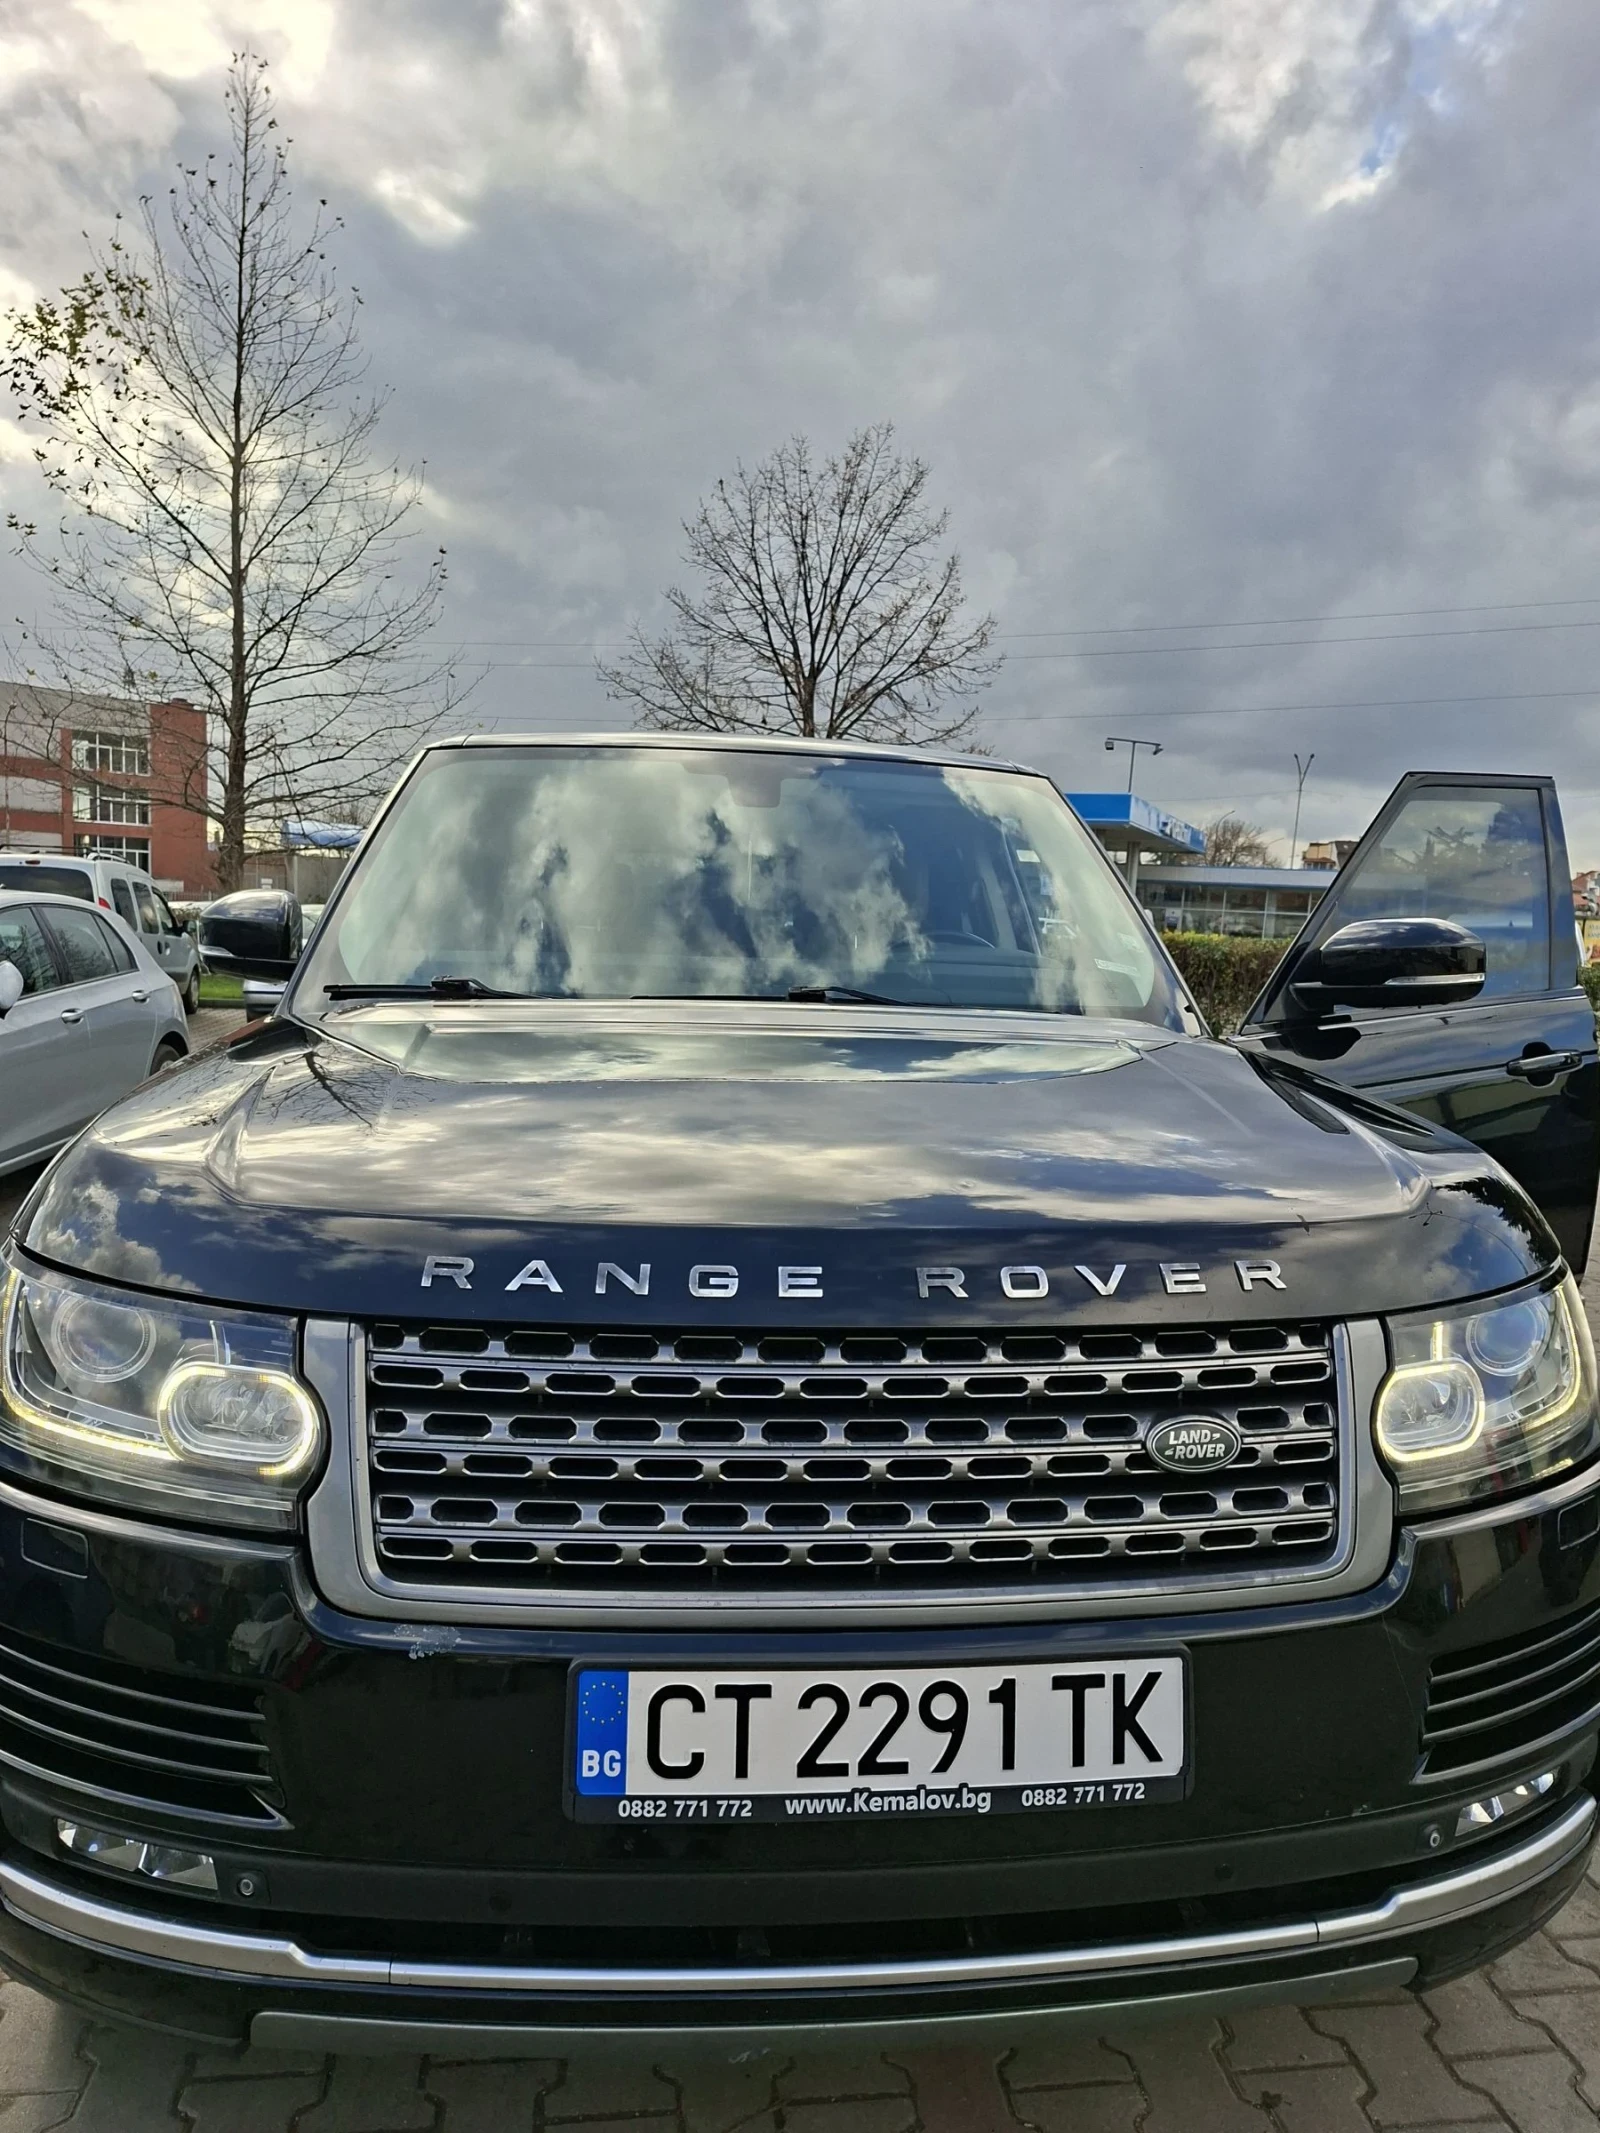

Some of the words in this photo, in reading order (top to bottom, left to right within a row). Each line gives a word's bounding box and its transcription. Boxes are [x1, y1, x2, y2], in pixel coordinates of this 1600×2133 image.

[420, 1255, 824, 1299] RANGE
[916, 1259, 1288, 1299] ROVER
[1168, 1429, 1211, 1445] LAND
[1174, 1443, 1226, 1460] ROVER
[646, 1683, 773, 1780] CT
[795, 1677, 1016, 1778] 2291
[1051, 1670, 1164, 1768] TK
[581, 1749, 622, 1778] BG
[785, 1786, 992, 1814] www.Kemalov.bg
[1021, 1787, 1068, 1807] 0882
[1073, 1785, 1106, 1804] 771
[1112, 1782, 1146, 1802] 772
[617, 1799, 668, 1819] 0882
[673, 1800, 709, 1818] 771
[716, 1800, 753, 1818] 772
